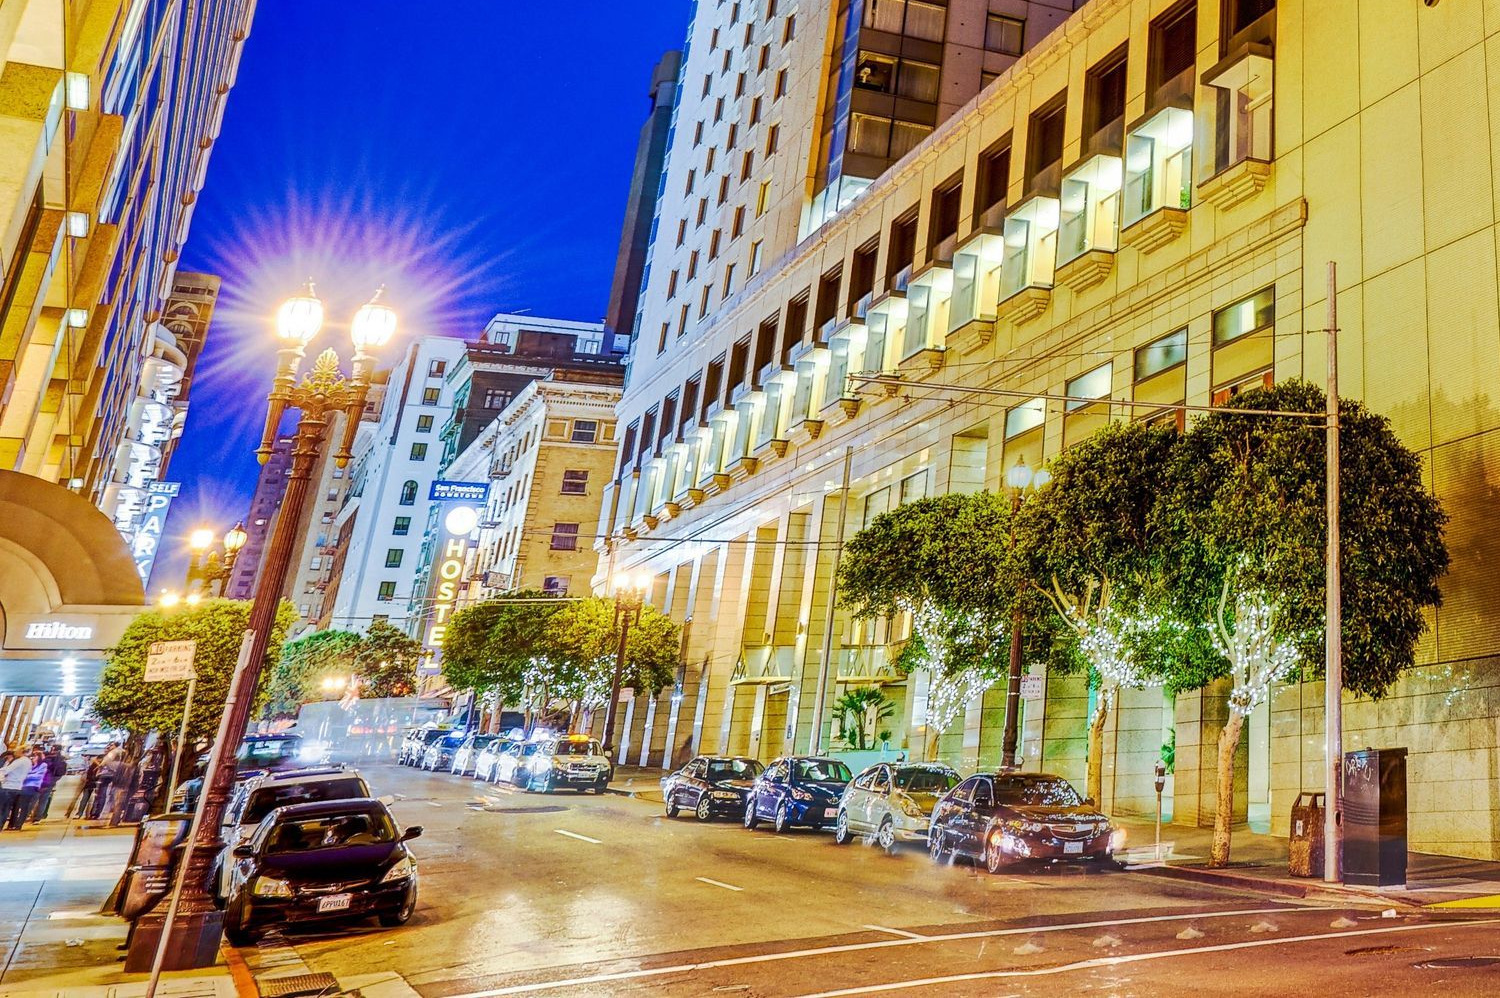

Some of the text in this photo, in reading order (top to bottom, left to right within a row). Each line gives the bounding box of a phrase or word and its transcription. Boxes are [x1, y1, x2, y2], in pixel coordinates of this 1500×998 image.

[149, 483, 178, 493] SELF
[451, 484, 485, 493] Francisco
[423, 539, 465, 669] HOSTEL
[25, 622, 92, 639] Hilton
